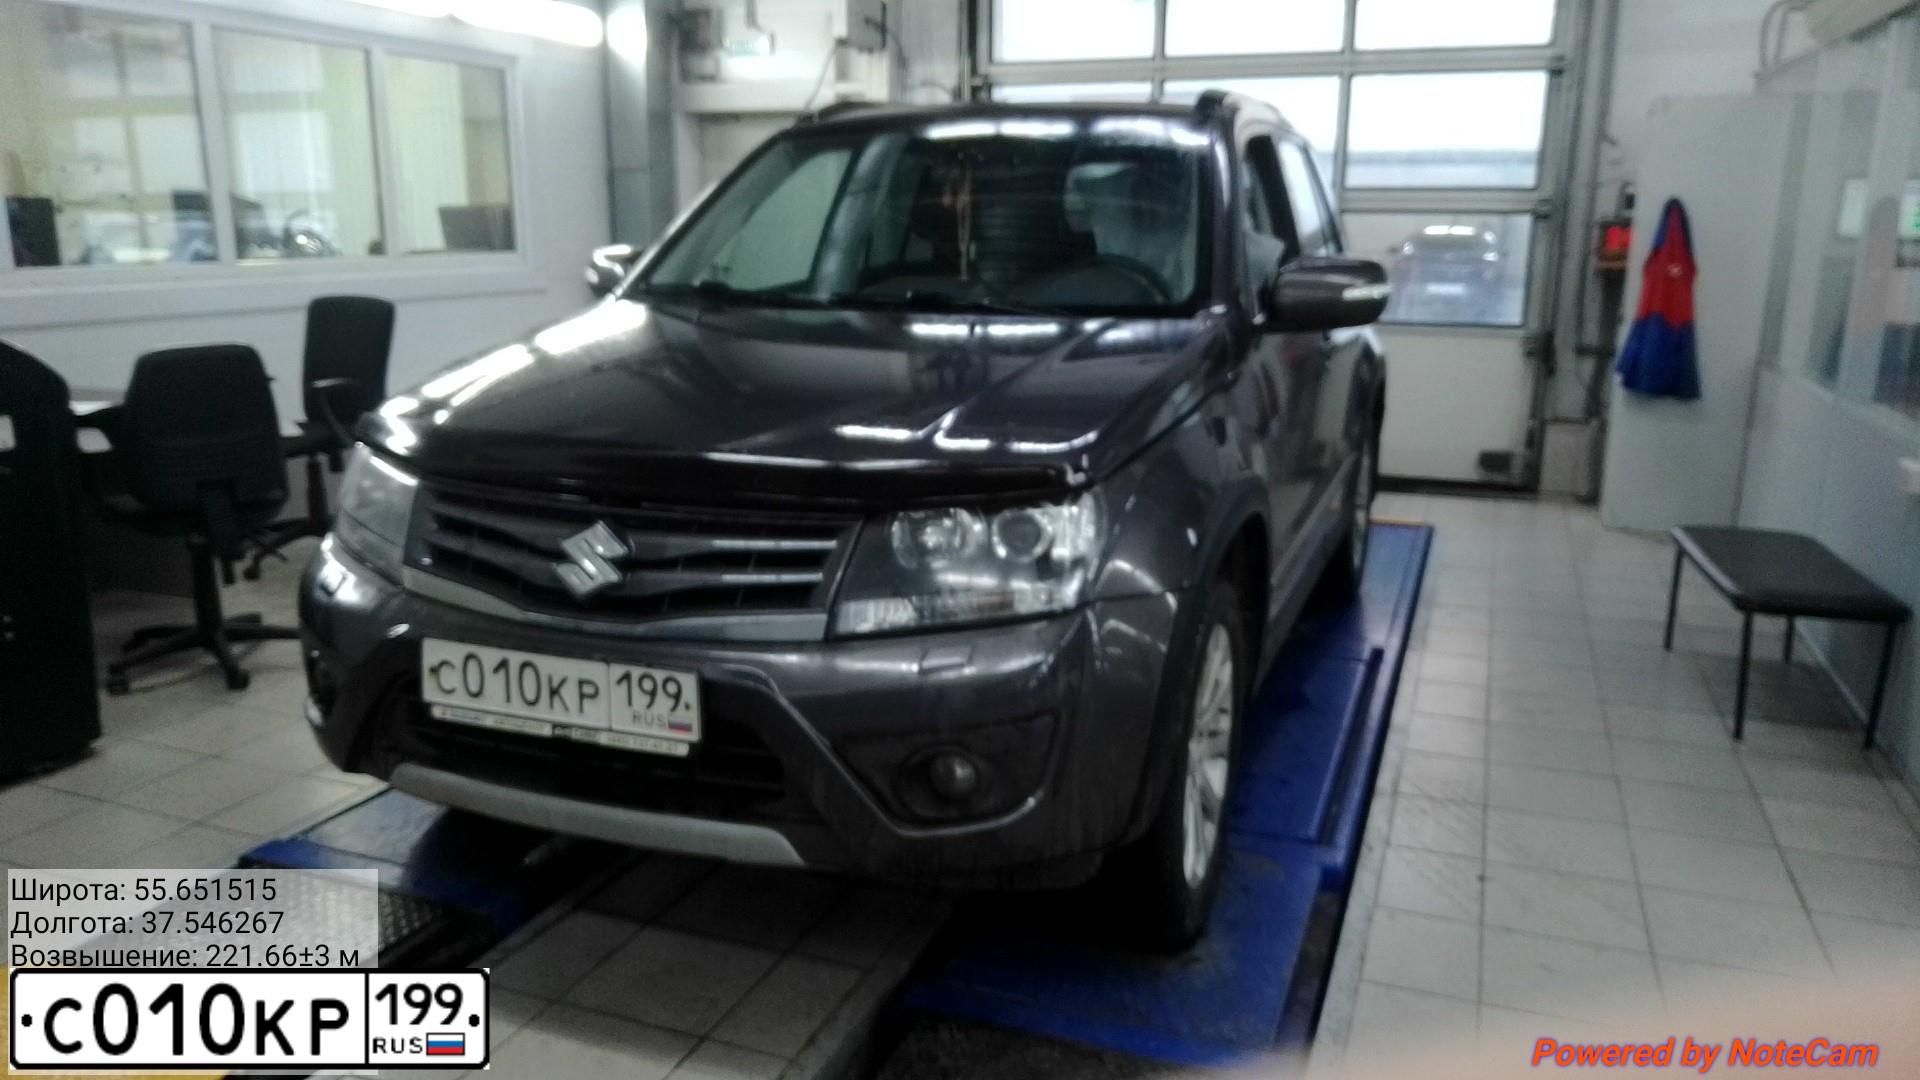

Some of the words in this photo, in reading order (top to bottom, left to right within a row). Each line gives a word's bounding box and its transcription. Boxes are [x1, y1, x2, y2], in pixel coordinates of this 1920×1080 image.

[436, 652, 600, 714] С010КР
[615, 670, 683, 712] 199
[632, 711, 666, 726] RUS
